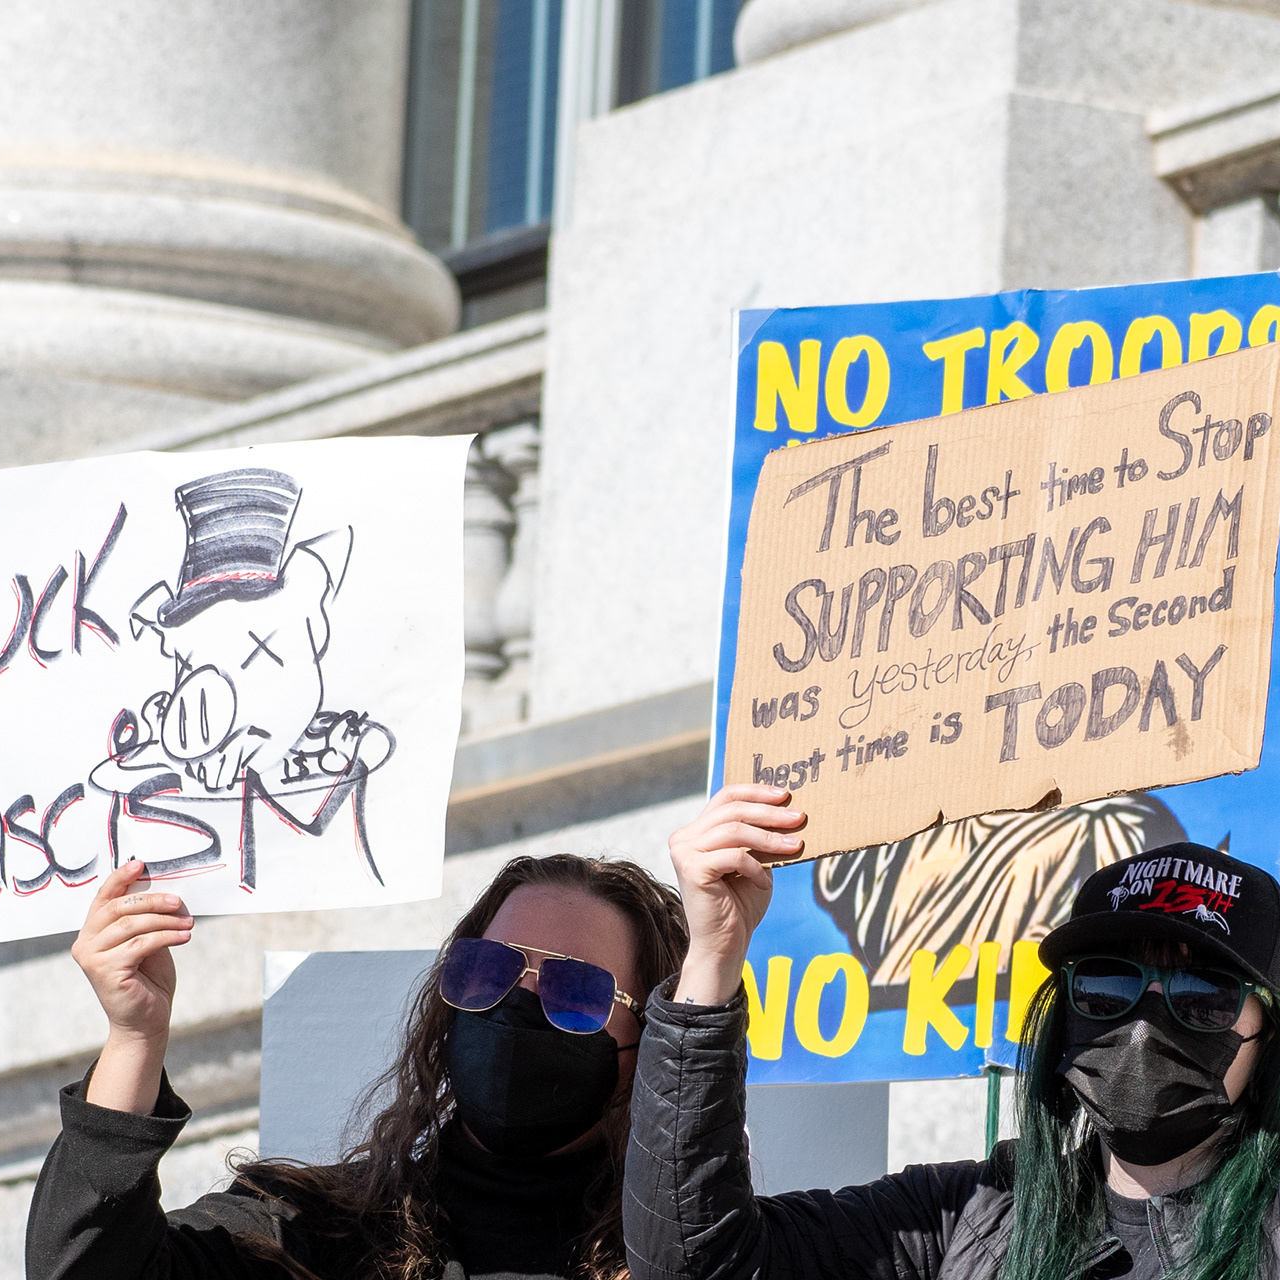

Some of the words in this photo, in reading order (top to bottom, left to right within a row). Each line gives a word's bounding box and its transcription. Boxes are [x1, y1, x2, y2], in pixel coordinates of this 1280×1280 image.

[754, 335, 890, 433] NO
[783, 440, 901, 553] The
[923, 444, 1020, 538] best
[1041, 462, 1104, 511] time
[1114, 448, 1149, 488] to
[1157, 390, 1272, 480] Stop
[773, 516, 1114, 673] SUPPORTING
[1130, 485, 1243, 584] HIM
[752, 686, 822, 729] was
[838, 622, 1041, 730] yesterday,
[1046, 606, 1095, 655] the
[752, 748, 826, 791] best
[836, 730, 909, 772] time
[930, 712, 962, 745] is
[986, 645, 1228, 763] TODAY
[1120, 857, 1244, 899] NIGHTMARE
[1130, 878, 1155, 896] ON
[743, 953, 869, 1060] NO
